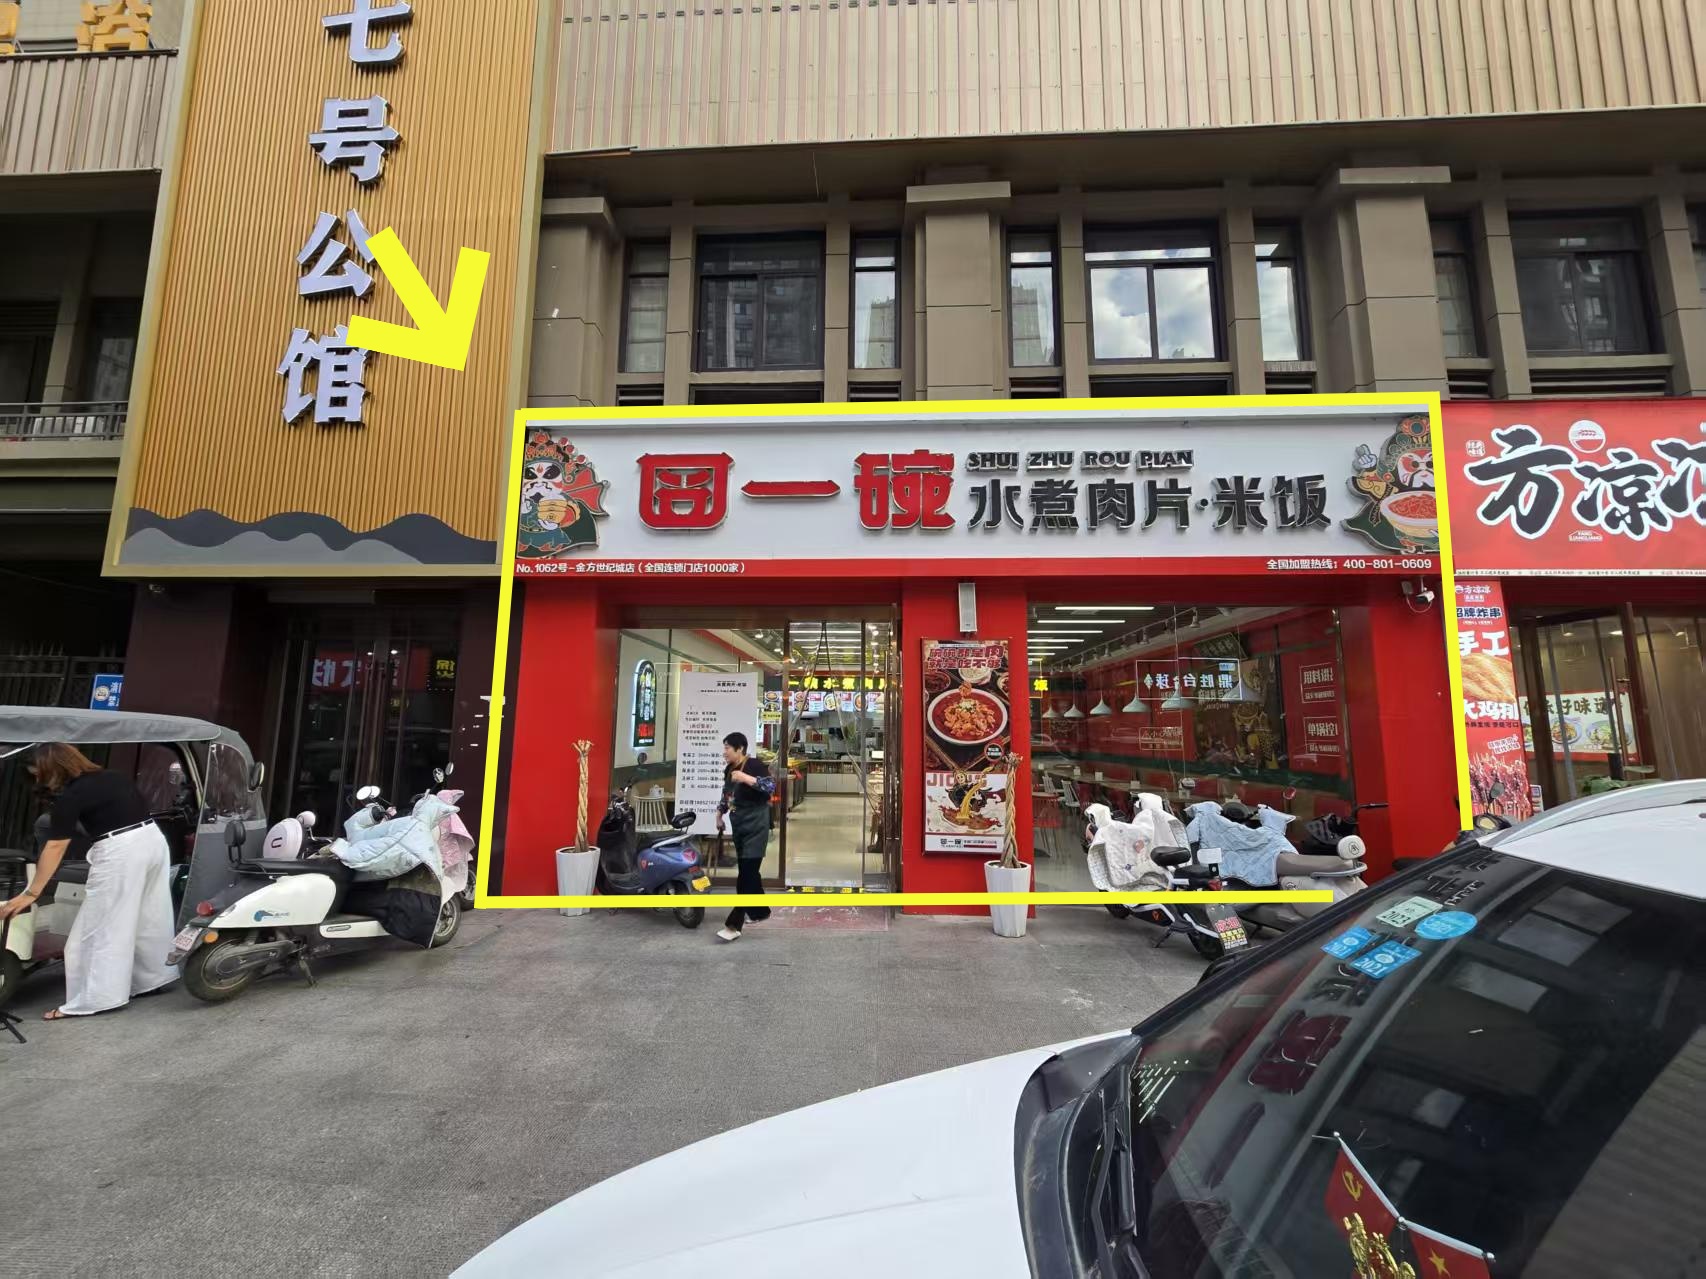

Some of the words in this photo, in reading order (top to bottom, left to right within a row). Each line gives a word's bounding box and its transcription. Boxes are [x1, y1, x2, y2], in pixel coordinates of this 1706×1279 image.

[276, 0, 415, 425] 七号公馆
[966, 451, 1020, 472] SHUI
[1026, 451, 1075, 471] ZHU
[1080, 450, 1132, 470] ROU
[1135, 449, 1194, 470] PIAN
[1354, 957, 1388, 976] 2021
